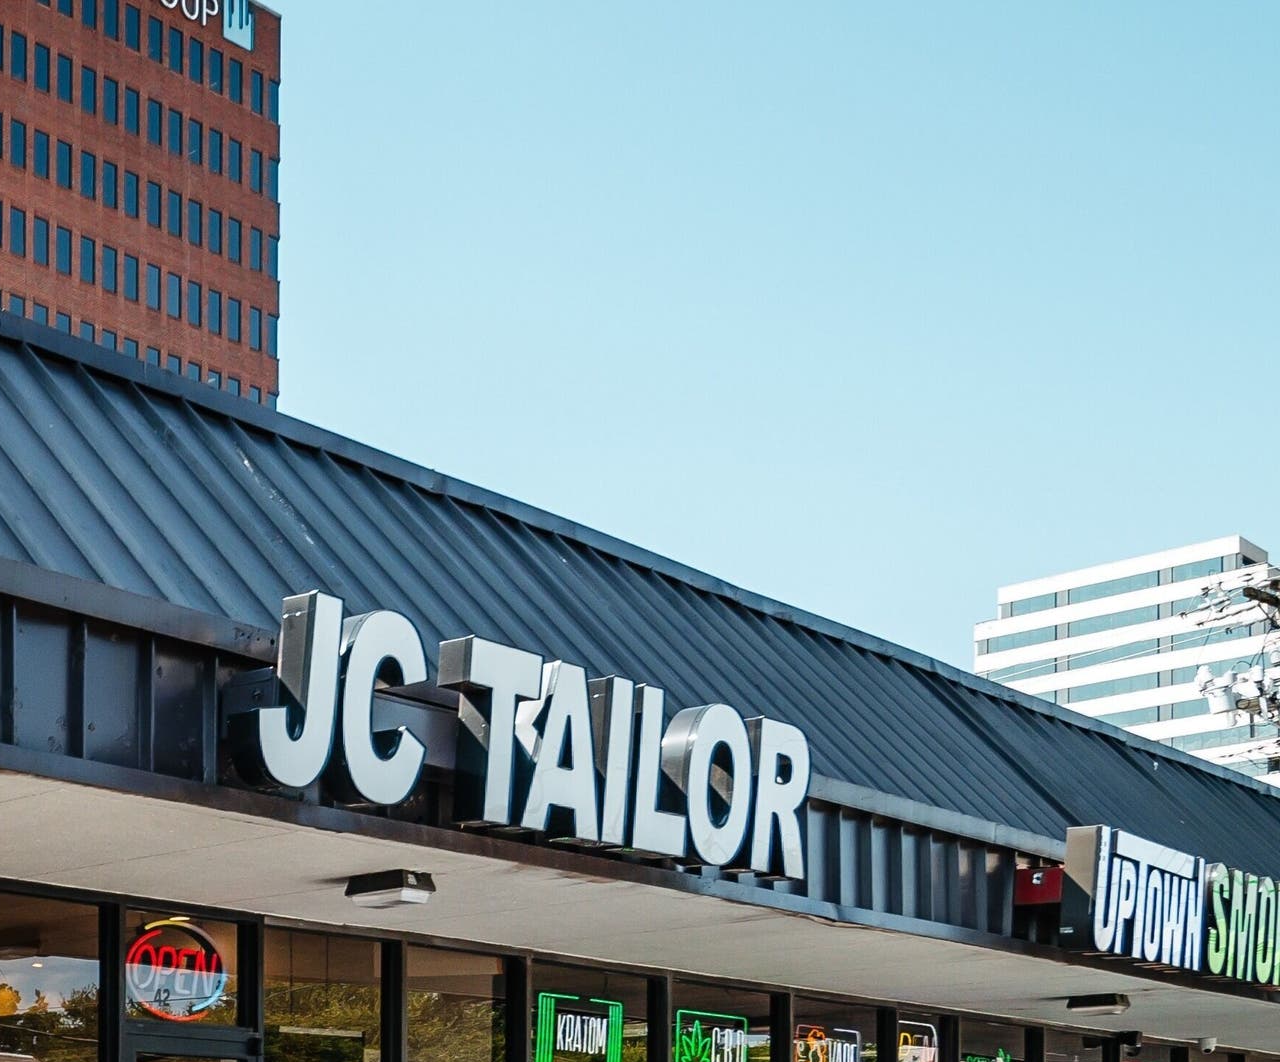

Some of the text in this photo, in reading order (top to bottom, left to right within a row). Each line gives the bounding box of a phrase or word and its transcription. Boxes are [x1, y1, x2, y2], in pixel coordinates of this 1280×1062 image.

[257, 590, 811, 880] JC TAILOR
[1092, 825, 1280, 985] UPTOWN SMO
[132, 943, 218, 998] OPEN
[556, 1013, 608, 1055] KRATOM
